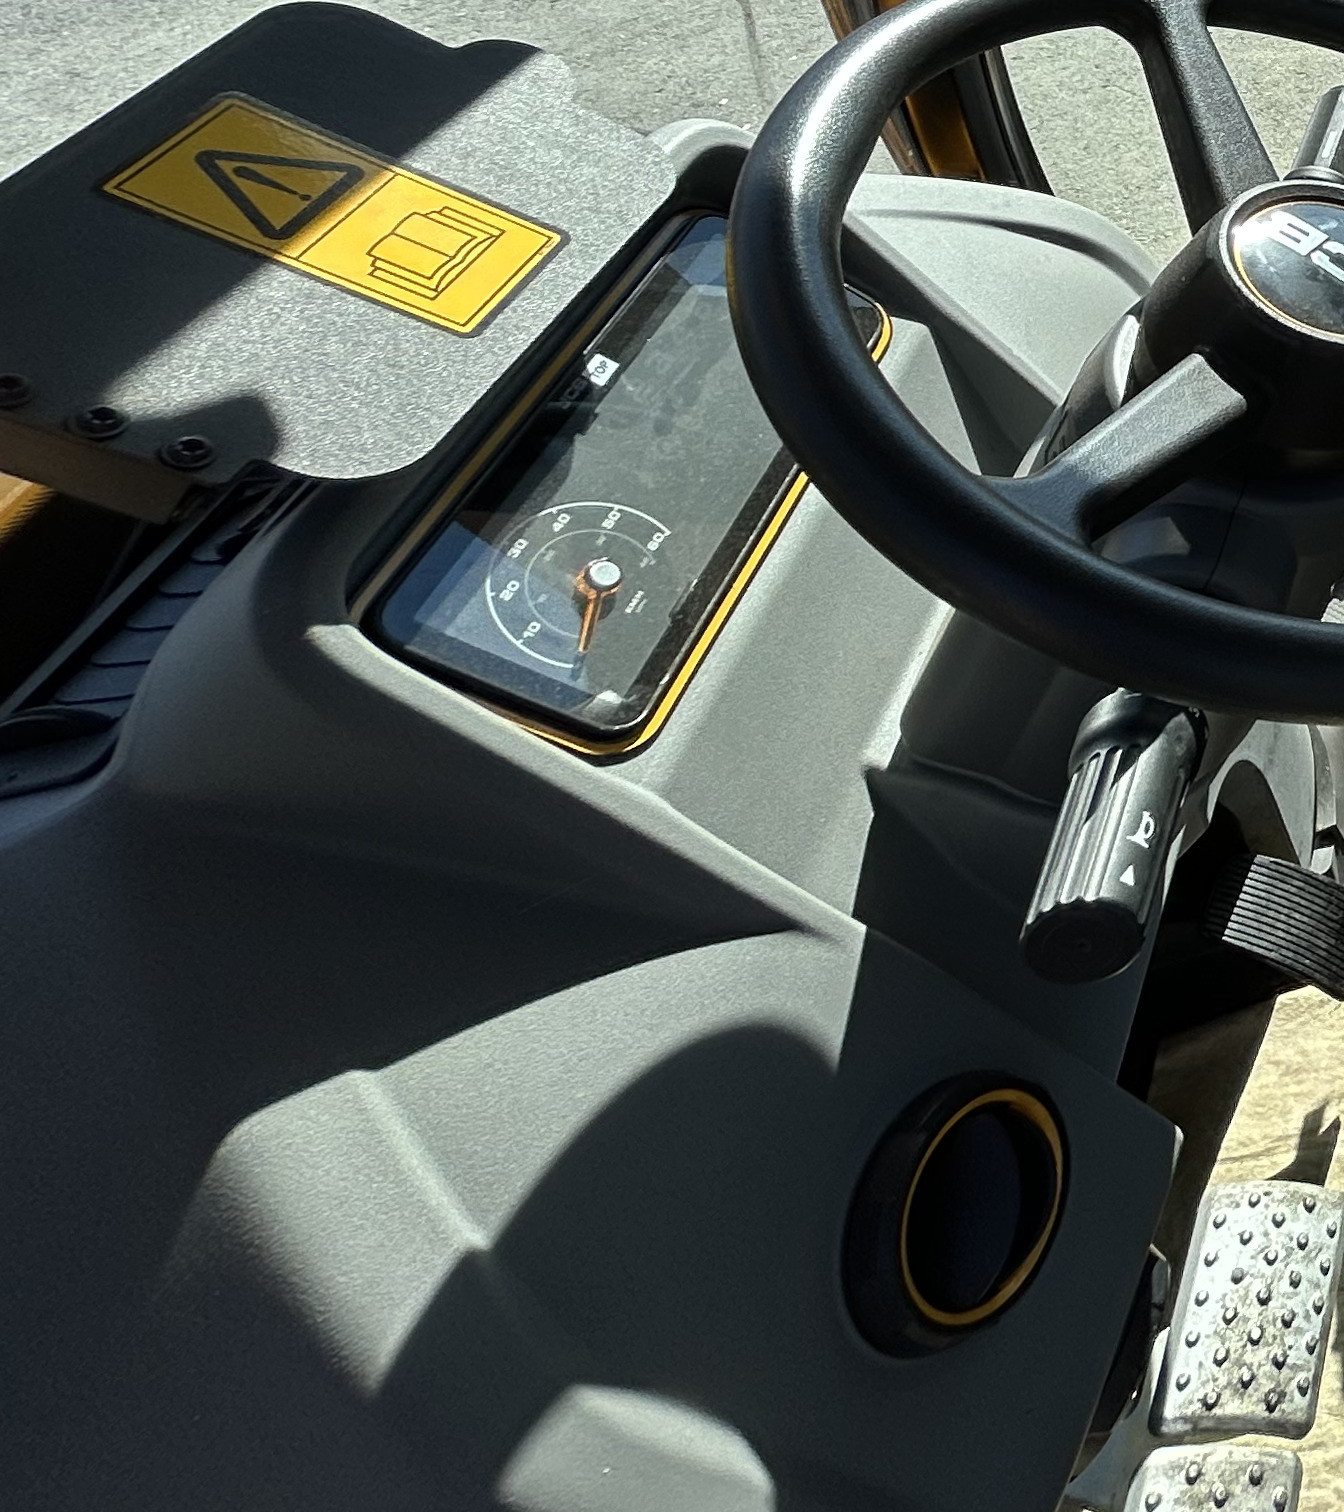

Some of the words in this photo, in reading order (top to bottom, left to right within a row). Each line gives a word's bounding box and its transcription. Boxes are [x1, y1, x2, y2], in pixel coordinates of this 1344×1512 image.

[590, 358, 610, 379] TOP
[551, 511, 572, 532] 40
[601, 510, 622, 530] 50
[506, 538, 529, 559] 30
[646, 530, 665, 552] 60
[498, 579, 520, 602] 20
[523, 620, 542, 641] 10
